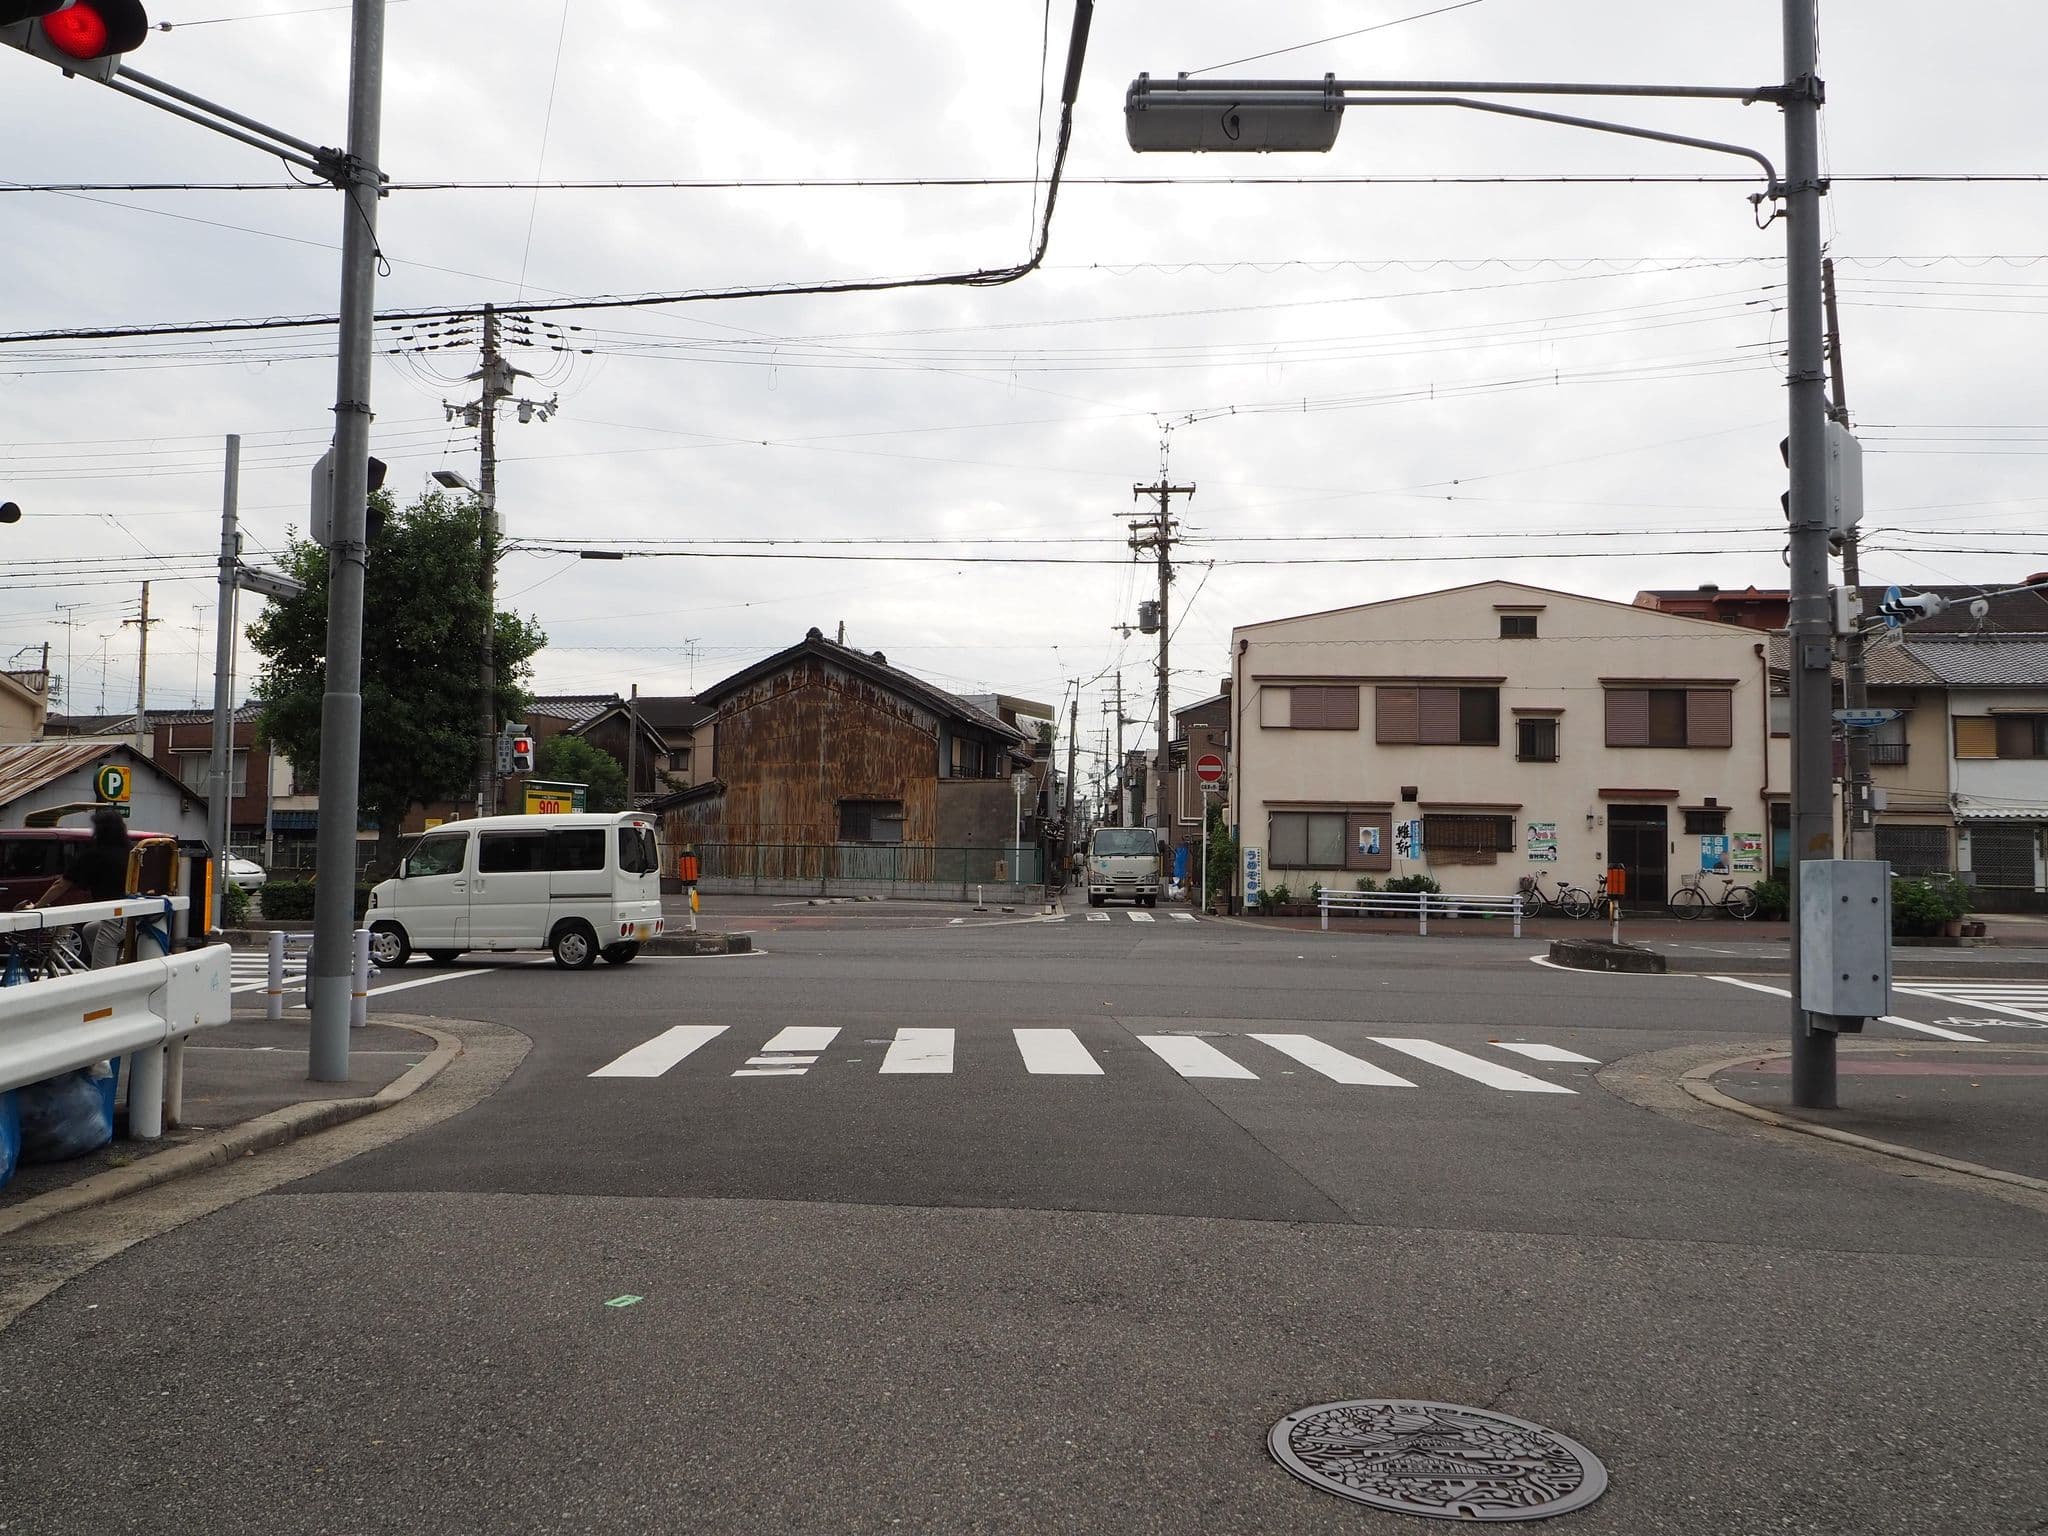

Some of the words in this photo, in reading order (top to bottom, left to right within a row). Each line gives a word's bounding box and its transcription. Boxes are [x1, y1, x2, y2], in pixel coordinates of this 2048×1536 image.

[108, 773, 121, 795] P
[539, 800, 560, 814] 900
[1395, 822, 1412, 858] 維新
